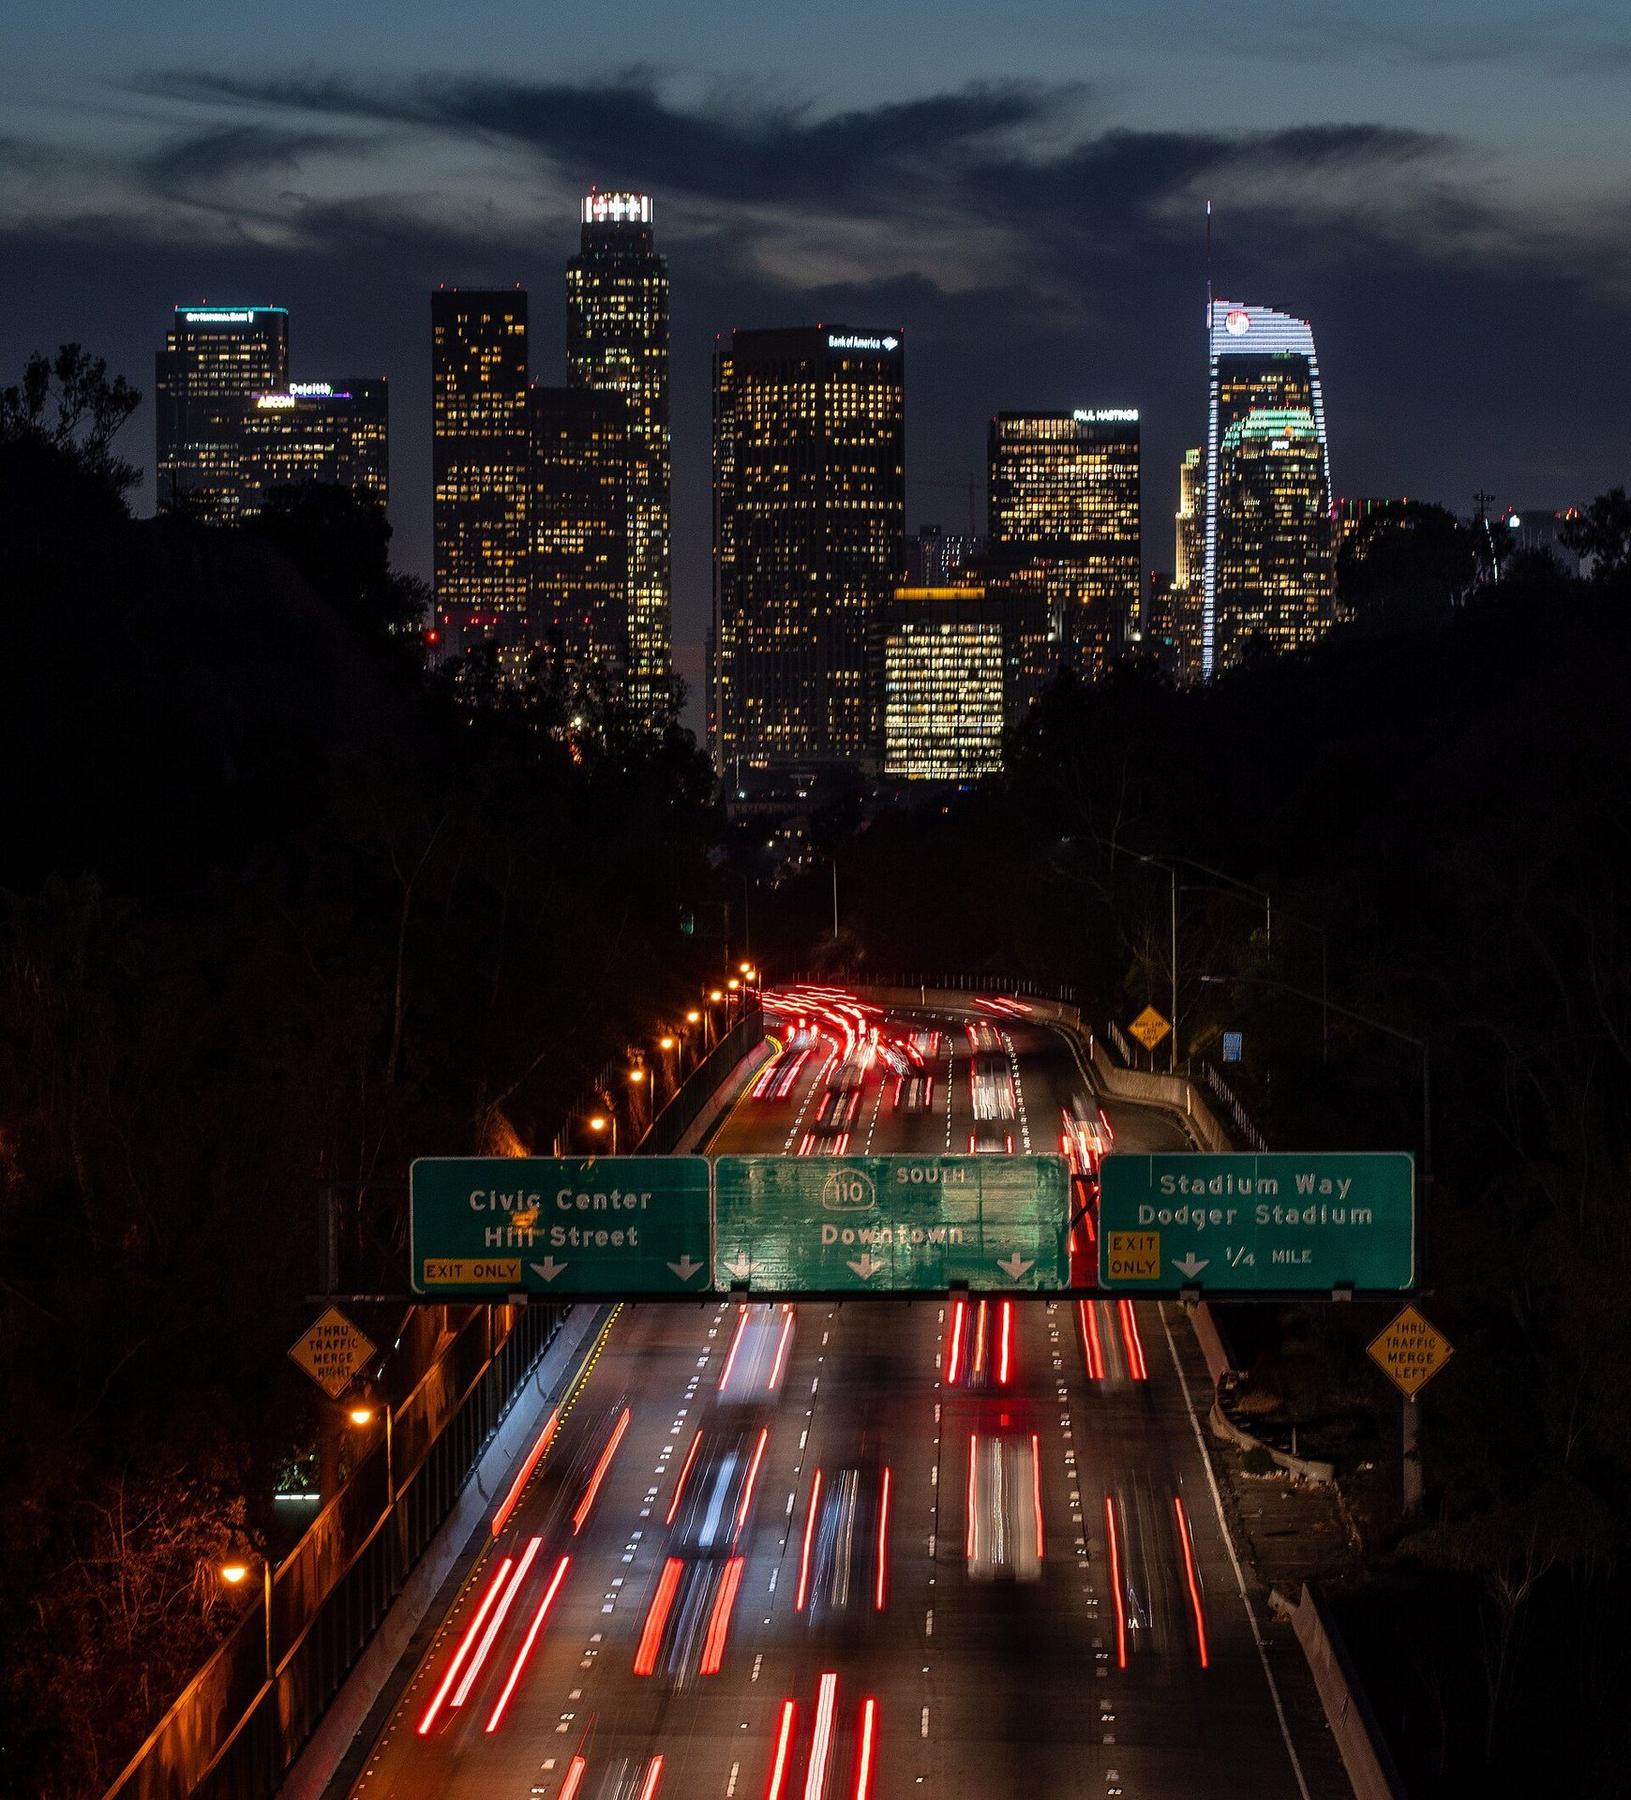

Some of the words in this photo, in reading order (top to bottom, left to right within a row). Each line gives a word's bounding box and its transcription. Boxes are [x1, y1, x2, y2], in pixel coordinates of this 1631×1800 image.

[896, 1167, 966, 1184] SOUTH
[834, 1181, 864, 1203] 110
[1160, 1174, 1279, 1195] Stadium
[1295, 1173, 1352, 1199] Way
[469, 1189, 540, 1211] Civic
[556, 1188, 651, 1210] Center
[1138, 1204, 1238, 1231] Dodger
[1255, 1204, 1373, 1225] Stadium
[484, 1226, 536, 1248] Hill
[550, 1225, 639, 1247] Street
[821, 1224, 965, 1245] Downtown
[1113, 1237, 1155, 1250] EXIT
[1271, 1250, 1312, 1264] MILE
[426, 1264, 463, 1278] EXIT
[473, 1264, 517, 1278] ONLY
[1111, 1260, 1155, 1274] ONLY
[318, 1326, 348, 1336] THRU
[1396, 1323, 1426, 1334] THRU
[309, 1339, 358, 1350] TRAFFIC
[1386, 1337, 1435, 1349] TRAFFIC
[313, 1352, 353, 1364] MERGE
[1387, 1352, 1434, 1364] MERGE
[1394, 1367, 1427, 1378] LEFT
